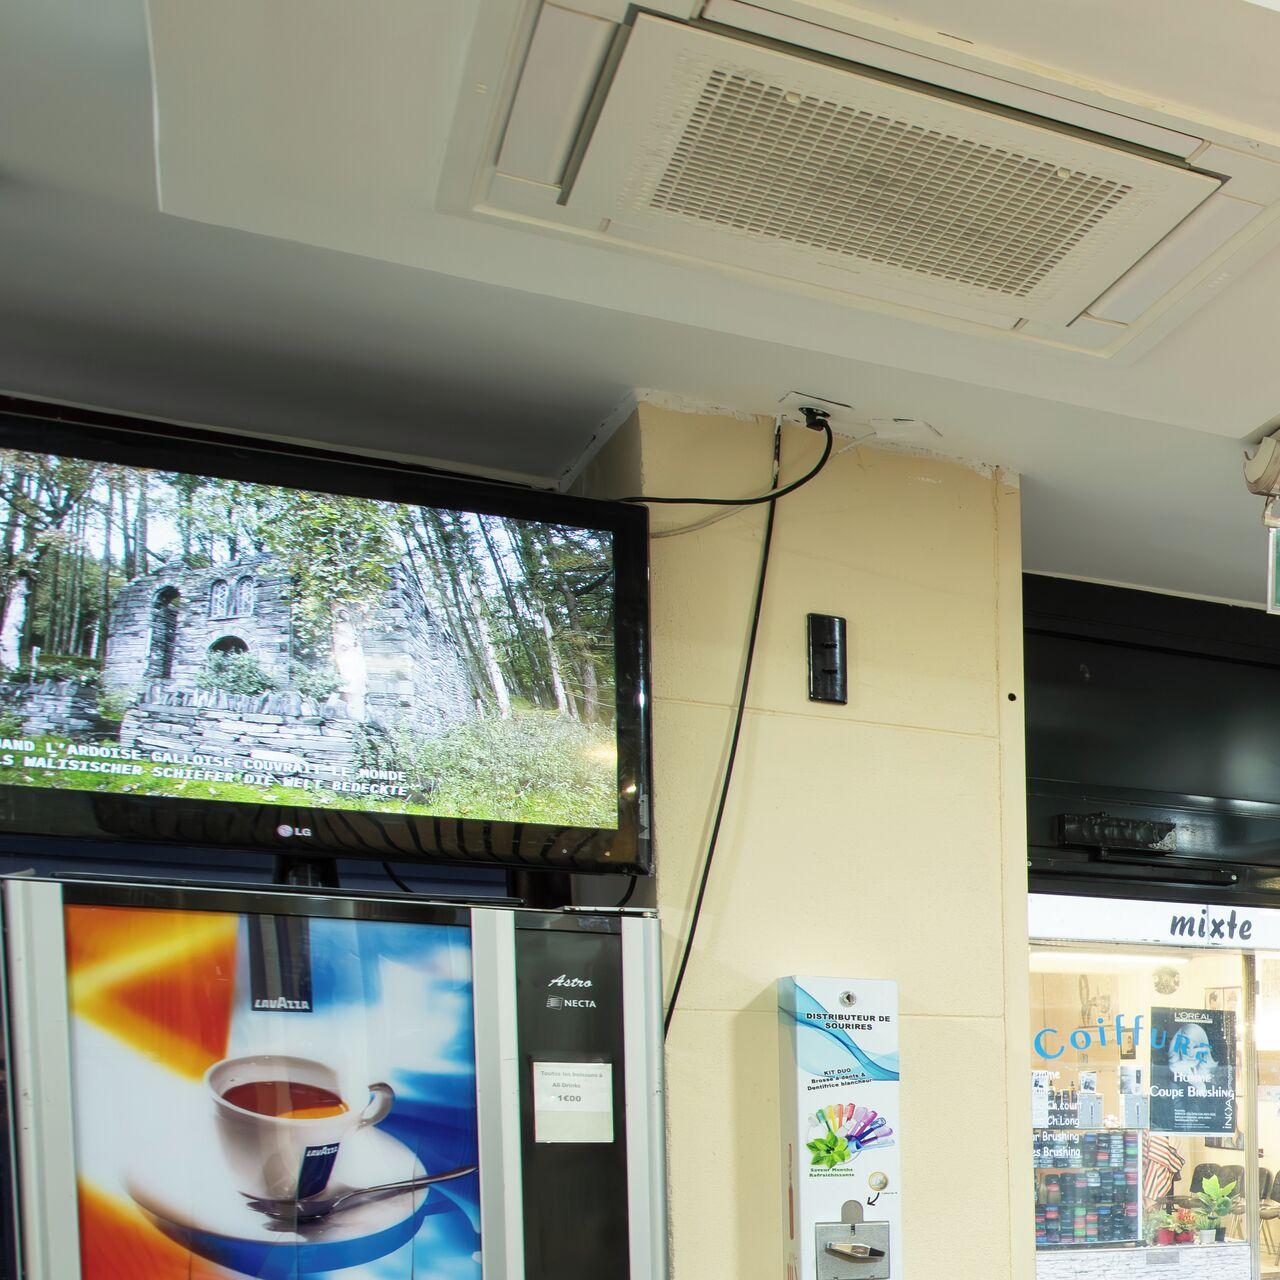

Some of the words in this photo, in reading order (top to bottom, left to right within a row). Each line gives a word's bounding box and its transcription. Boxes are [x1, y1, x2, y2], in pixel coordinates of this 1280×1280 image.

[46, 743, 141, 760] L'ARDOISE
[152, 752, 234, 768] GALLOISE
[244, 759, 321, 774] COUVRAIT
[359, 769, 407, 782] MONDE
[24, 757, 143, 775] WALISISCHER
[152, 767, 234, 782] SCHIEFER
[244, 773, 274, 786] DIE
[282, 777, 322, 790] WELT
[333, 781, 407, 796] BEDECKTE
[295, 827, 312, 836] LG
[1170, 908, 1253, 941] mixte
[548, 974, 593, 988] Astro
[254, 997, 310, 1009] LAVAZZA
[564, 999, 596, 1008] NECTA
[806, 1012, 876, 1022] DISTRIBUTEUR
[825, 1022, 873, 1030] SOURIRES
[1042, 1131, 1079, 1143] Brushing
[306, 1146, 338, 1157] LAVAZZA
[1044, 1146, 1081, 1159] Brushing
